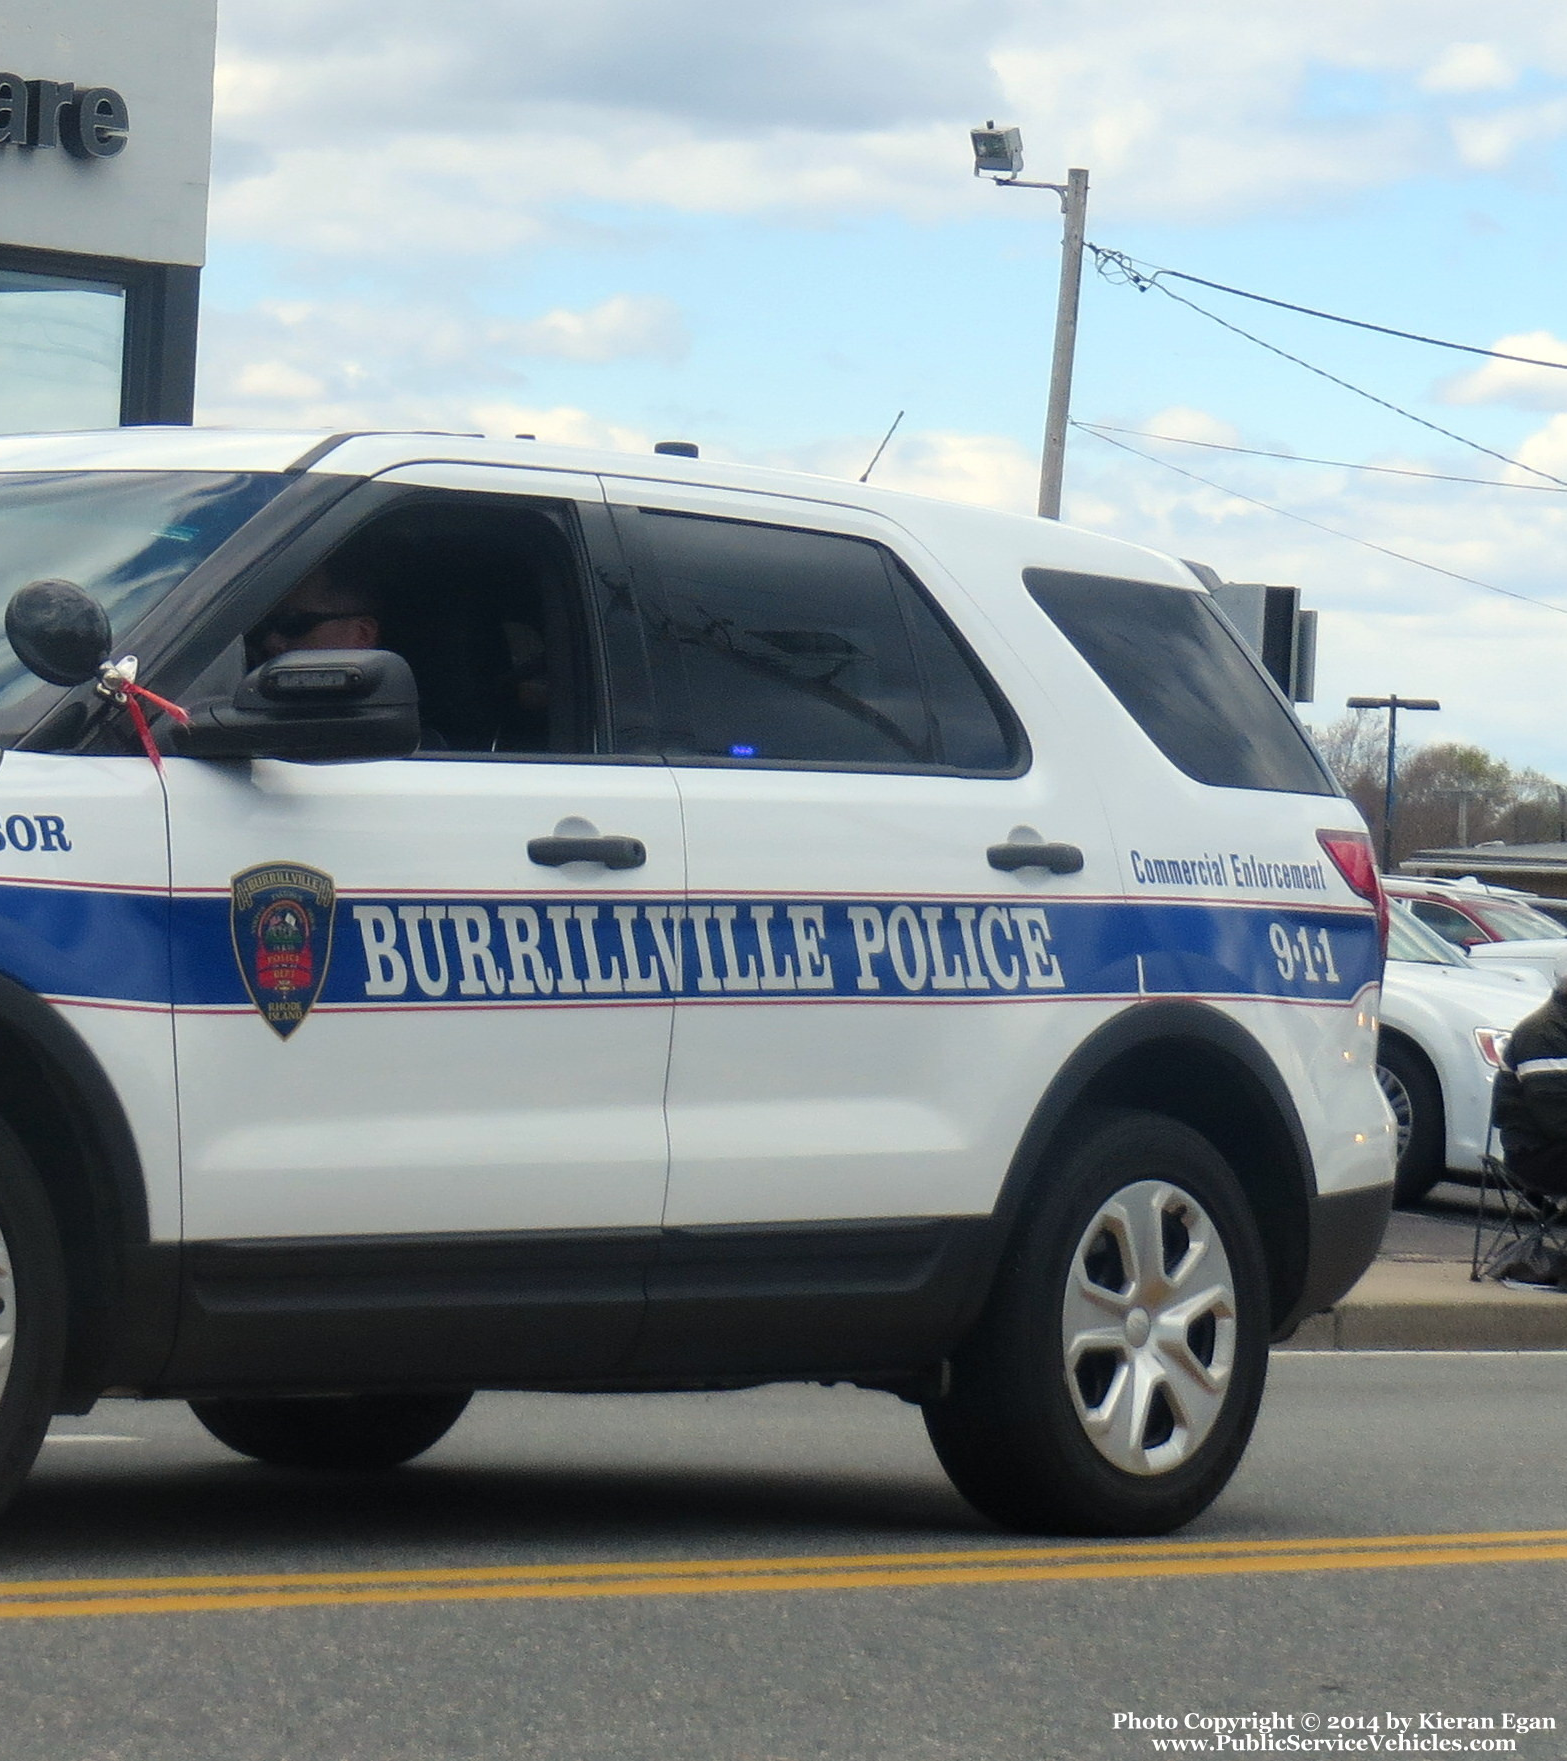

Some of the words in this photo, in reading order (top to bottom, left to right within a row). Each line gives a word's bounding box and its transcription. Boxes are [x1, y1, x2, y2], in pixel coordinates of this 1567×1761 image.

[247, 870, 319, 891] BURRILLVILLE
[1131, 850, 1229, 886] Commercial
[1230, 853, 1327, 890] Enforcement
[353, 905, 834, 996] BURRILLVILLE
[848, 907, 1065, 991] POLICE
[268, 1002, 301, 1011] RHODE
[268, 1011, 303, 1020] ISLAND
